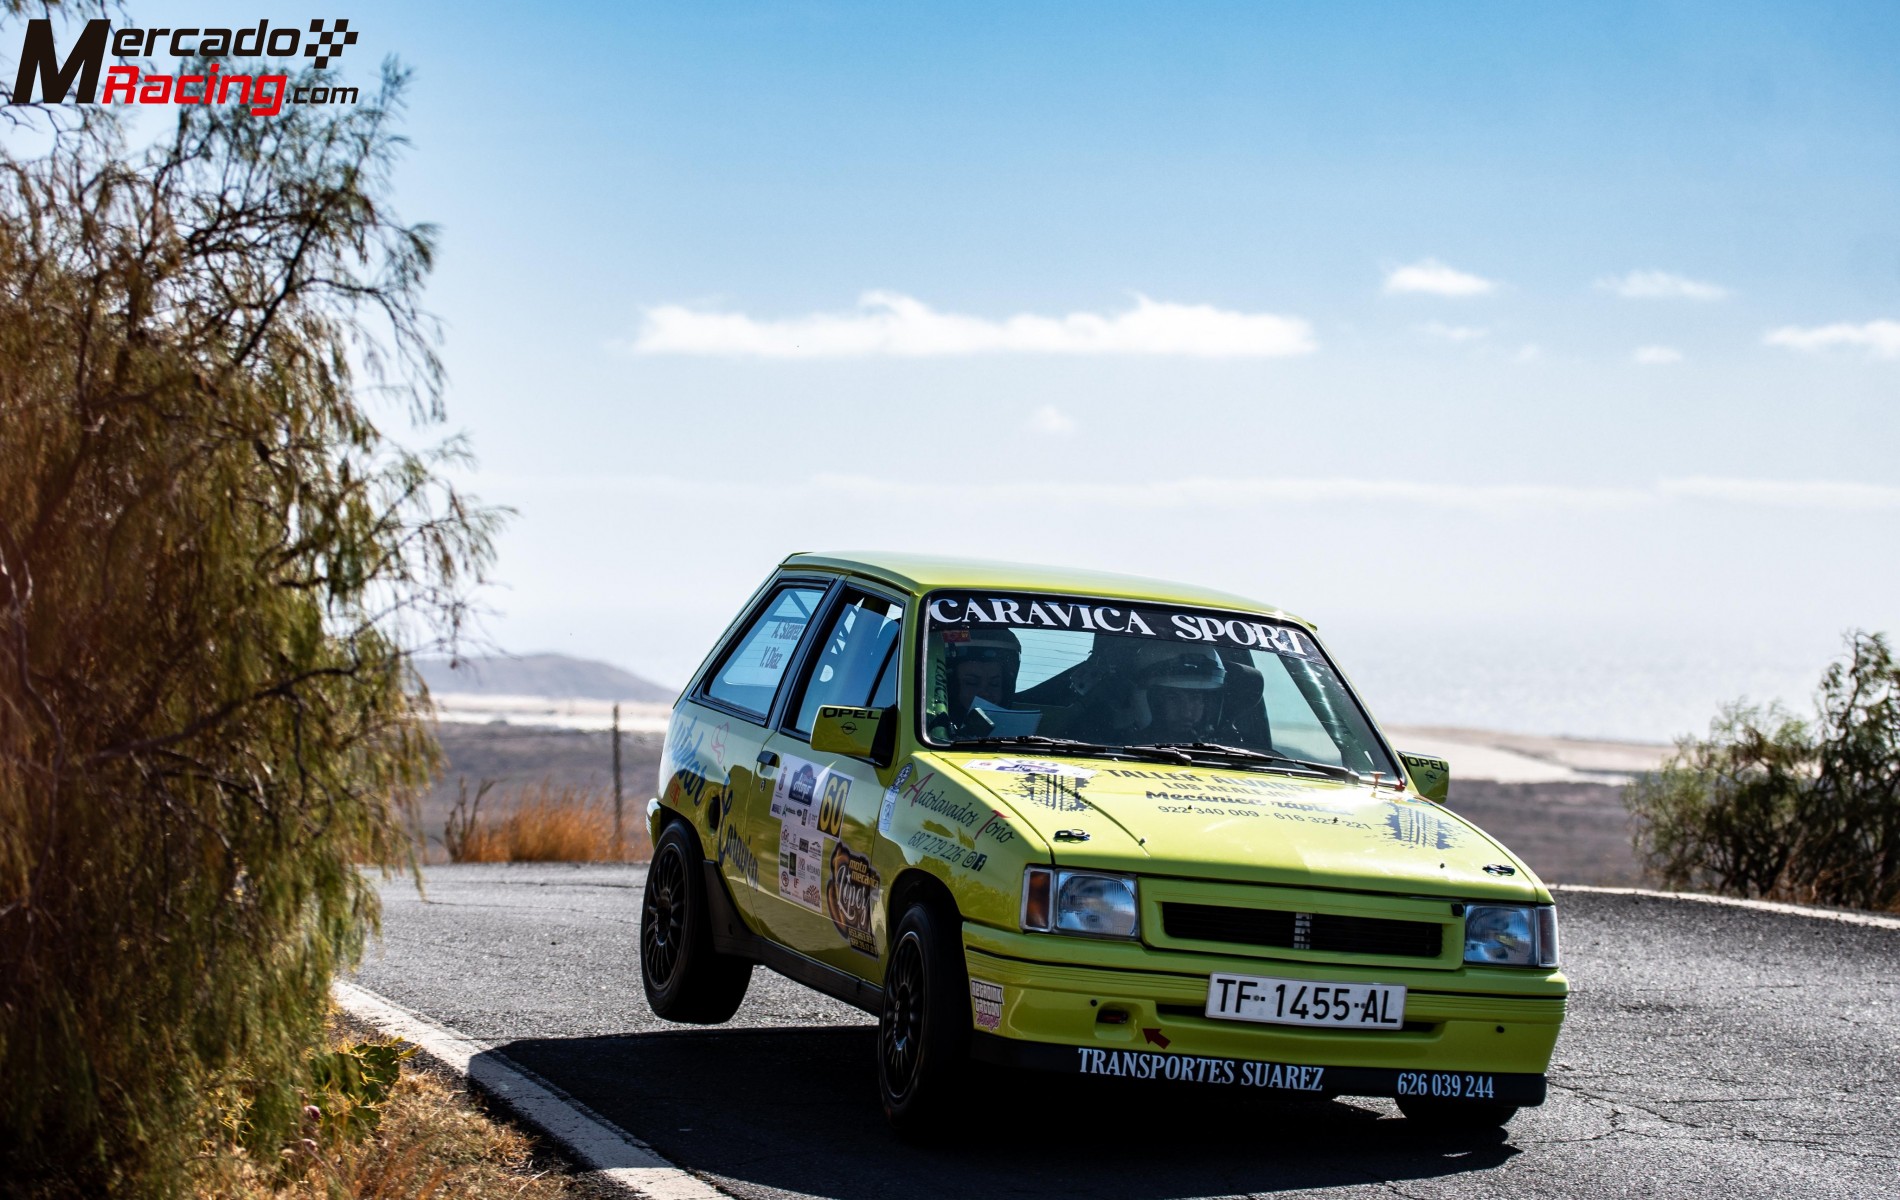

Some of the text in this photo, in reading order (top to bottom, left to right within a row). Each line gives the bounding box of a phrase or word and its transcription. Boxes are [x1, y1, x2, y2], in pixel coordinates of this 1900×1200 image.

[929, 597, 1307, 656] CARAVICA SPORT
[822, 707, 880, 720] OPEL
[1102, 768, 1204, 782] TALLER
[1406, 756, 1448, 773] OPEL
[1162, 782, 1202, 791] LOS
[819, 775, 849, 835] 60
[903, 772, 980, 828] Autolavados
[1270, 800, 1355, 817] rápi
[1157, 805, 1191, 814] 922
[1193, 806, 1225, 816] 340
[1228, 808, 1260, 818] 009
[1273, 811, 1305, 822] 616
[1341, 819, 1372, 830] 221
[1078, 1047, 1325, 1092] TRANSPORTES SUAREZ
[1397, 1072, 1494, 1099] 626 039 244
